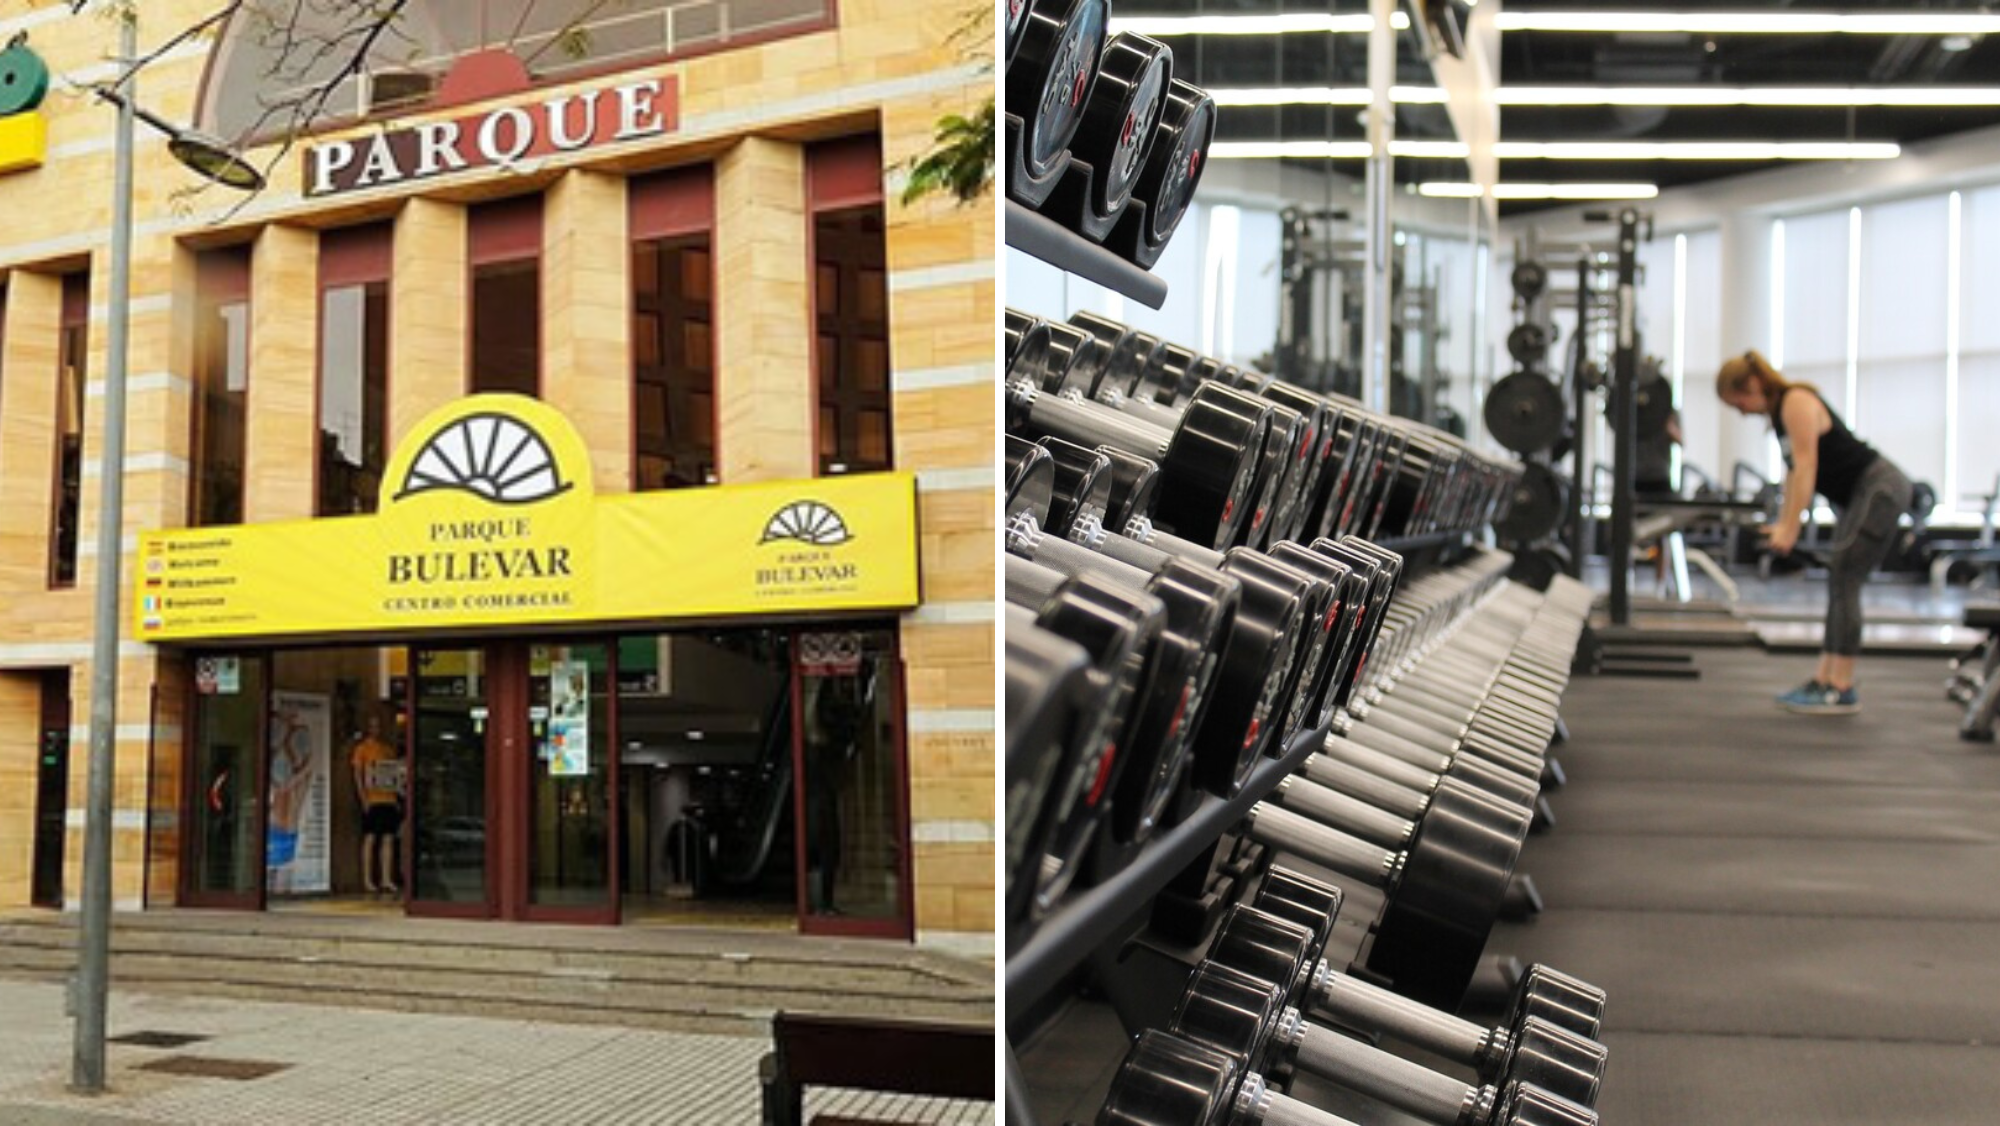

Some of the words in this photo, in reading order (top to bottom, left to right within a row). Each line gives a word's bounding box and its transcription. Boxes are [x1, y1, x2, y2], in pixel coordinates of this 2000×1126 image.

[309, 80, 664, 194] PARQUE
[430, 517, 531, 542] PARQUE
[388, 547, 571, 583] BULEVAR
[755, 564, 859, 585] BULEVAR
[383, 596, 457, 610] CENTRO
[462, 592, 572, 609] COMERCIAL
